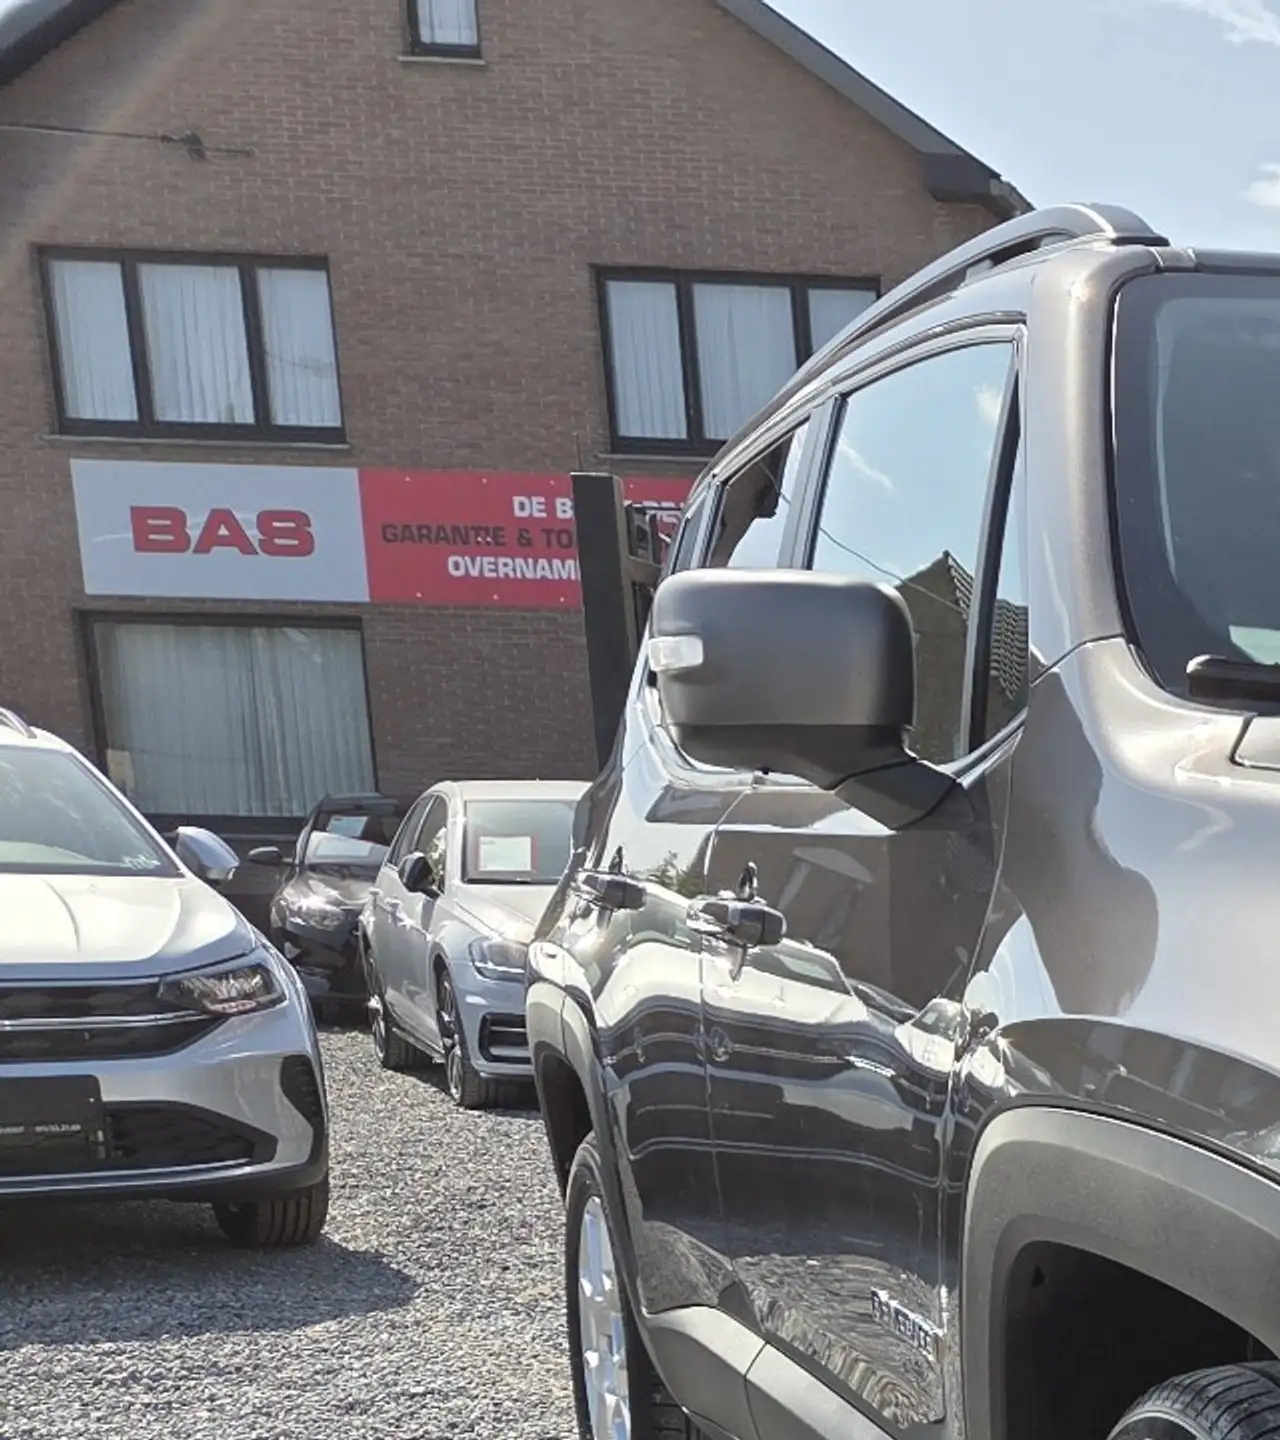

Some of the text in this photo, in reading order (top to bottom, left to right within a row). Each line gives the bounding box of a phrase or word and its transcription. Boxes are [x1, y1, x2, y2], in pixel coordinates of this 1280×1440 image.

[512, 495, 575, 520] DE B
[130, 505, 315, 558] BAS
[381, 523, 574, 550] GARANTIE & TO
[447, 554, 581, 581] OVERNAM
